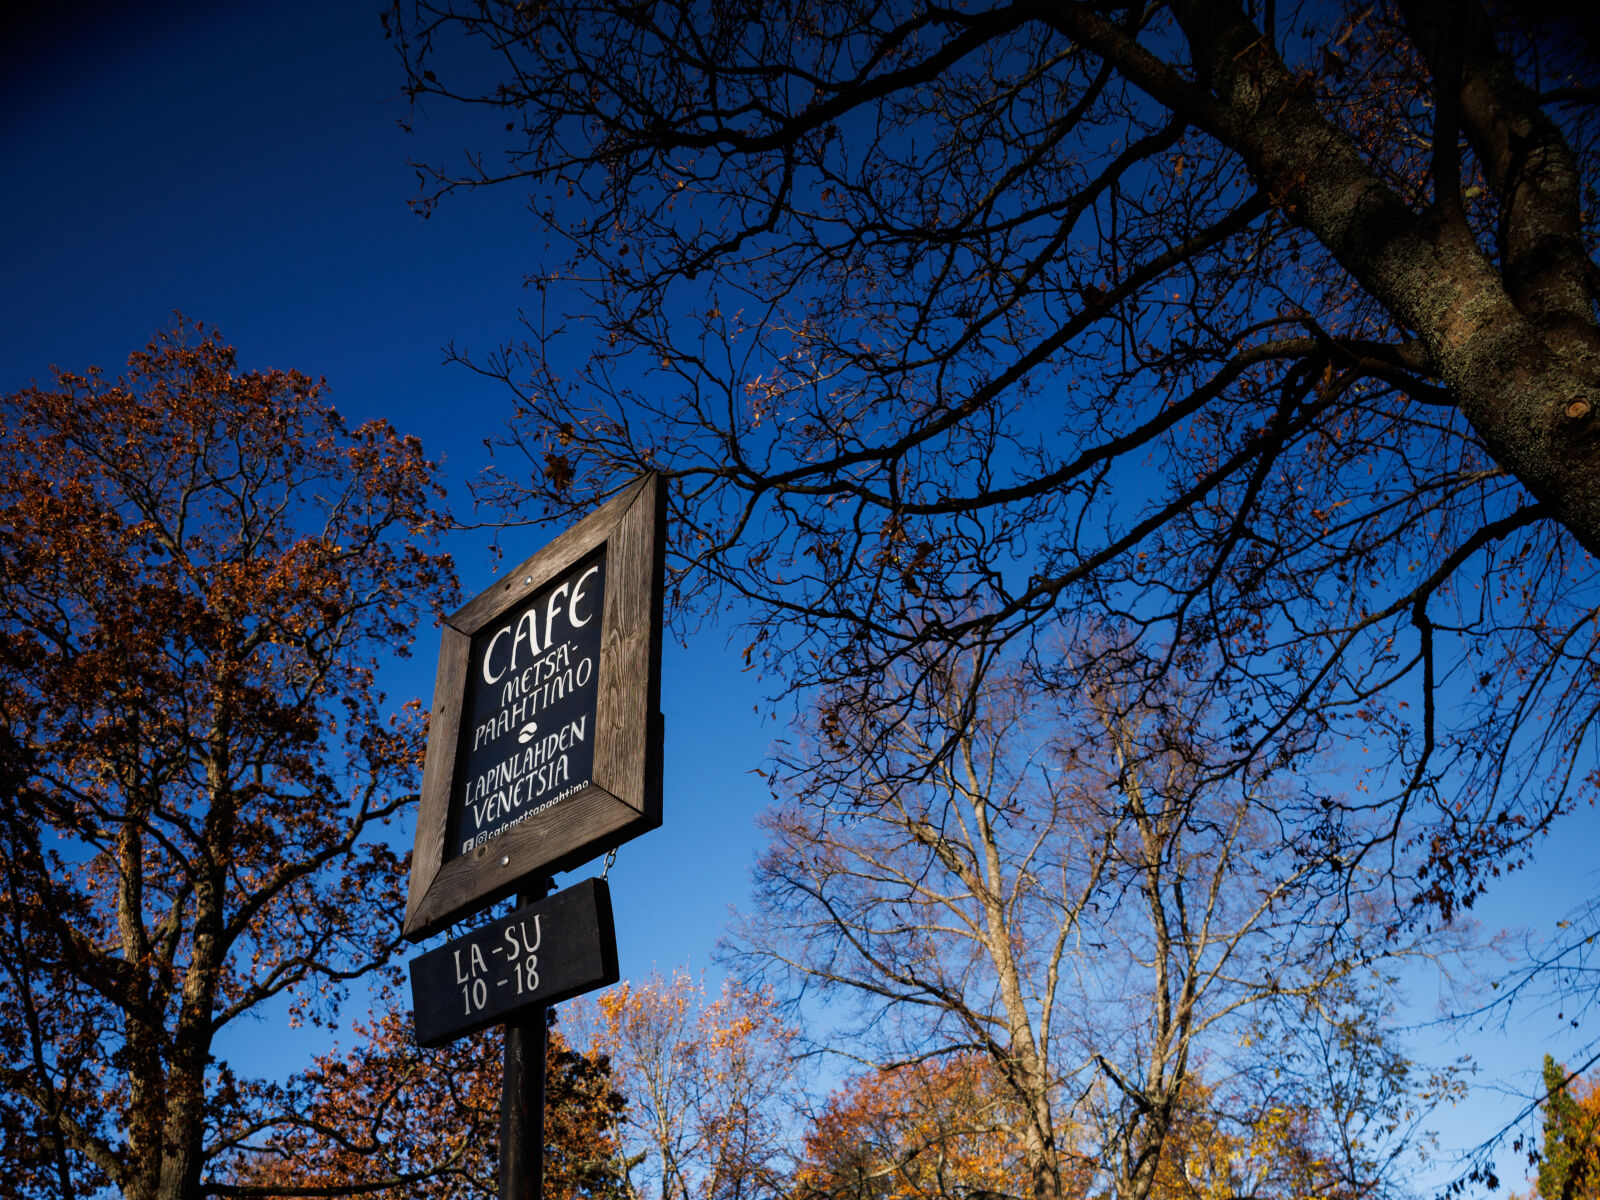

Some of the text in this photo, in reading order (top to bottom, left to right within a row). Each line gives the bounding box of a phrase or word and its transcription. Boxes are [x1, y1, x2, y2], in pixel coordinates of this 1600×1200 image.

[483, 566, 598, 684] CAFE
[473, 658, 592, 752] PAAHTIMO
[465, 714, 586, 806] LAPINLAHDEN
[473, 754, 570, 829] VENETSIA
